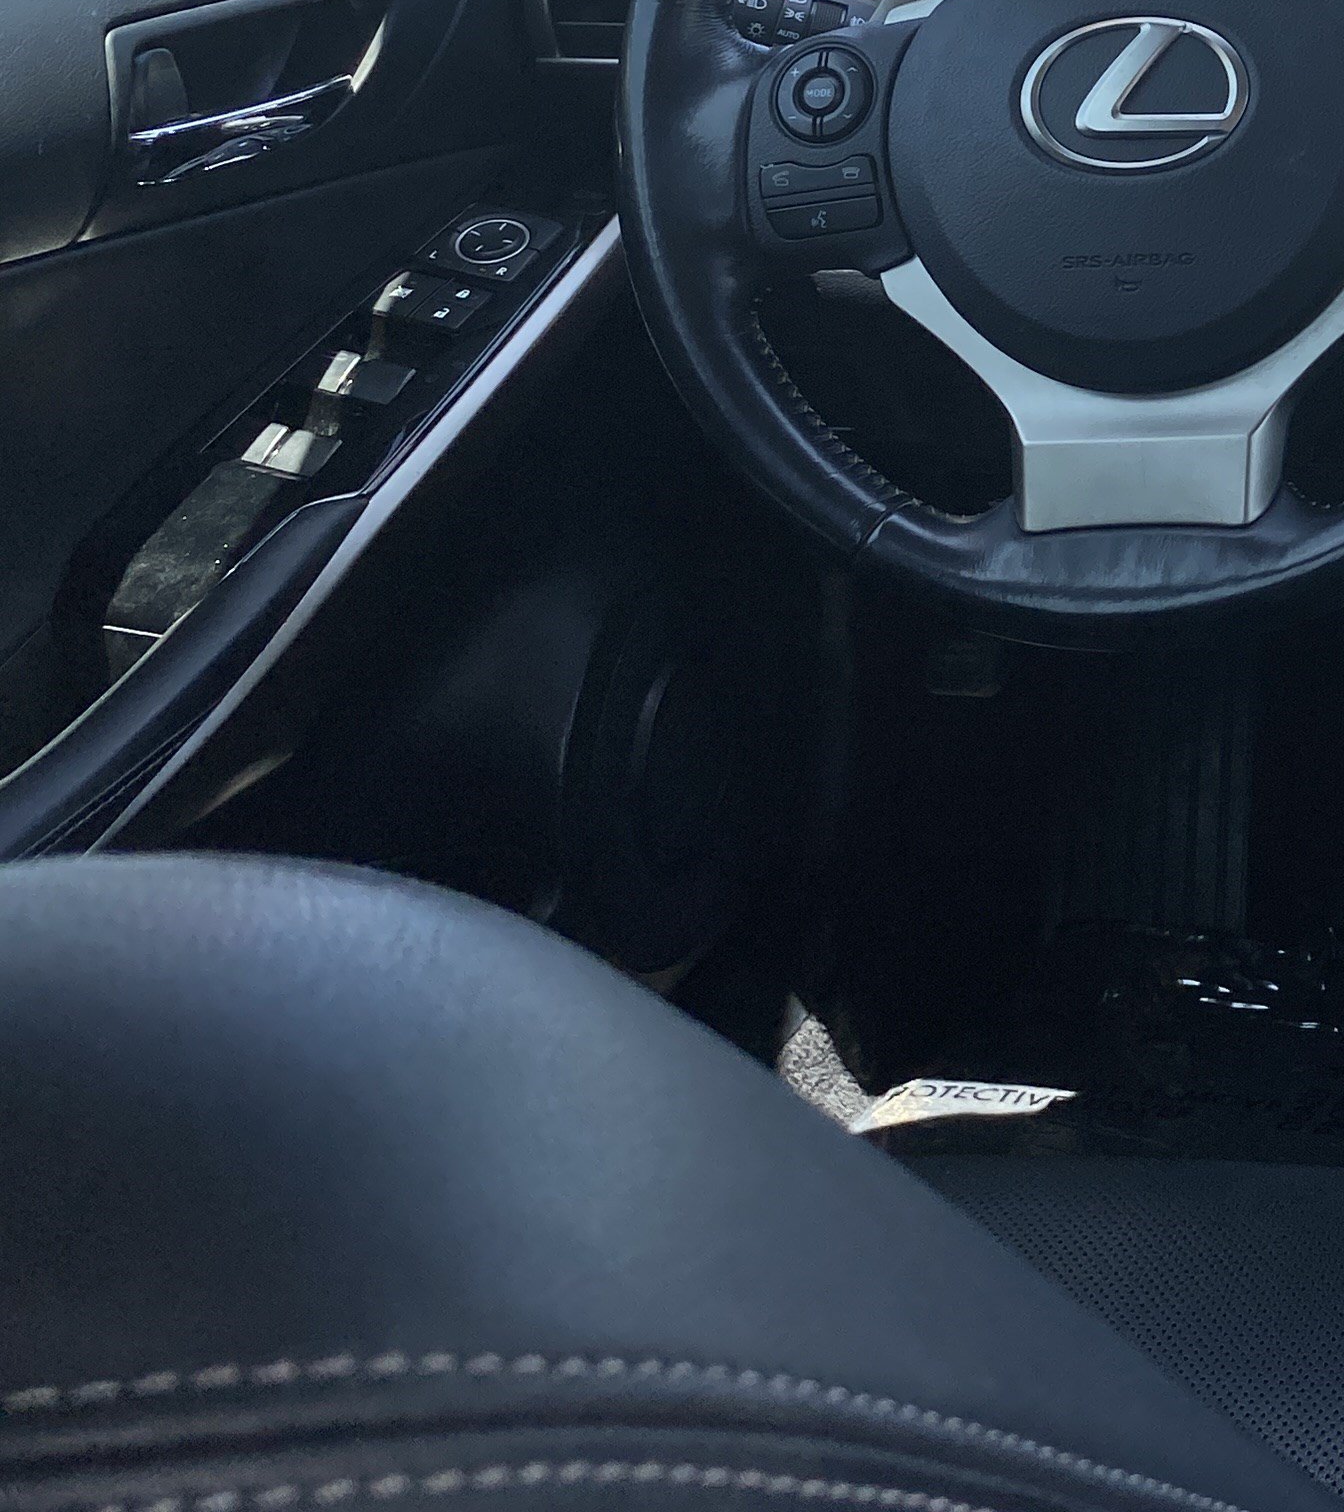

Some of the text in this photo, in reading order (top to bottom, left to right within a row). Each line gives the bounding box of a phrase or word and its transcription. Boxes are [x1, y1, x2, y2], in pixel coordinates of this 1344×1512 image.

[777, 28, 800, 40] AUTO
[806, 88, 833, 98] MODE
[495, 266, 508, 276] R
